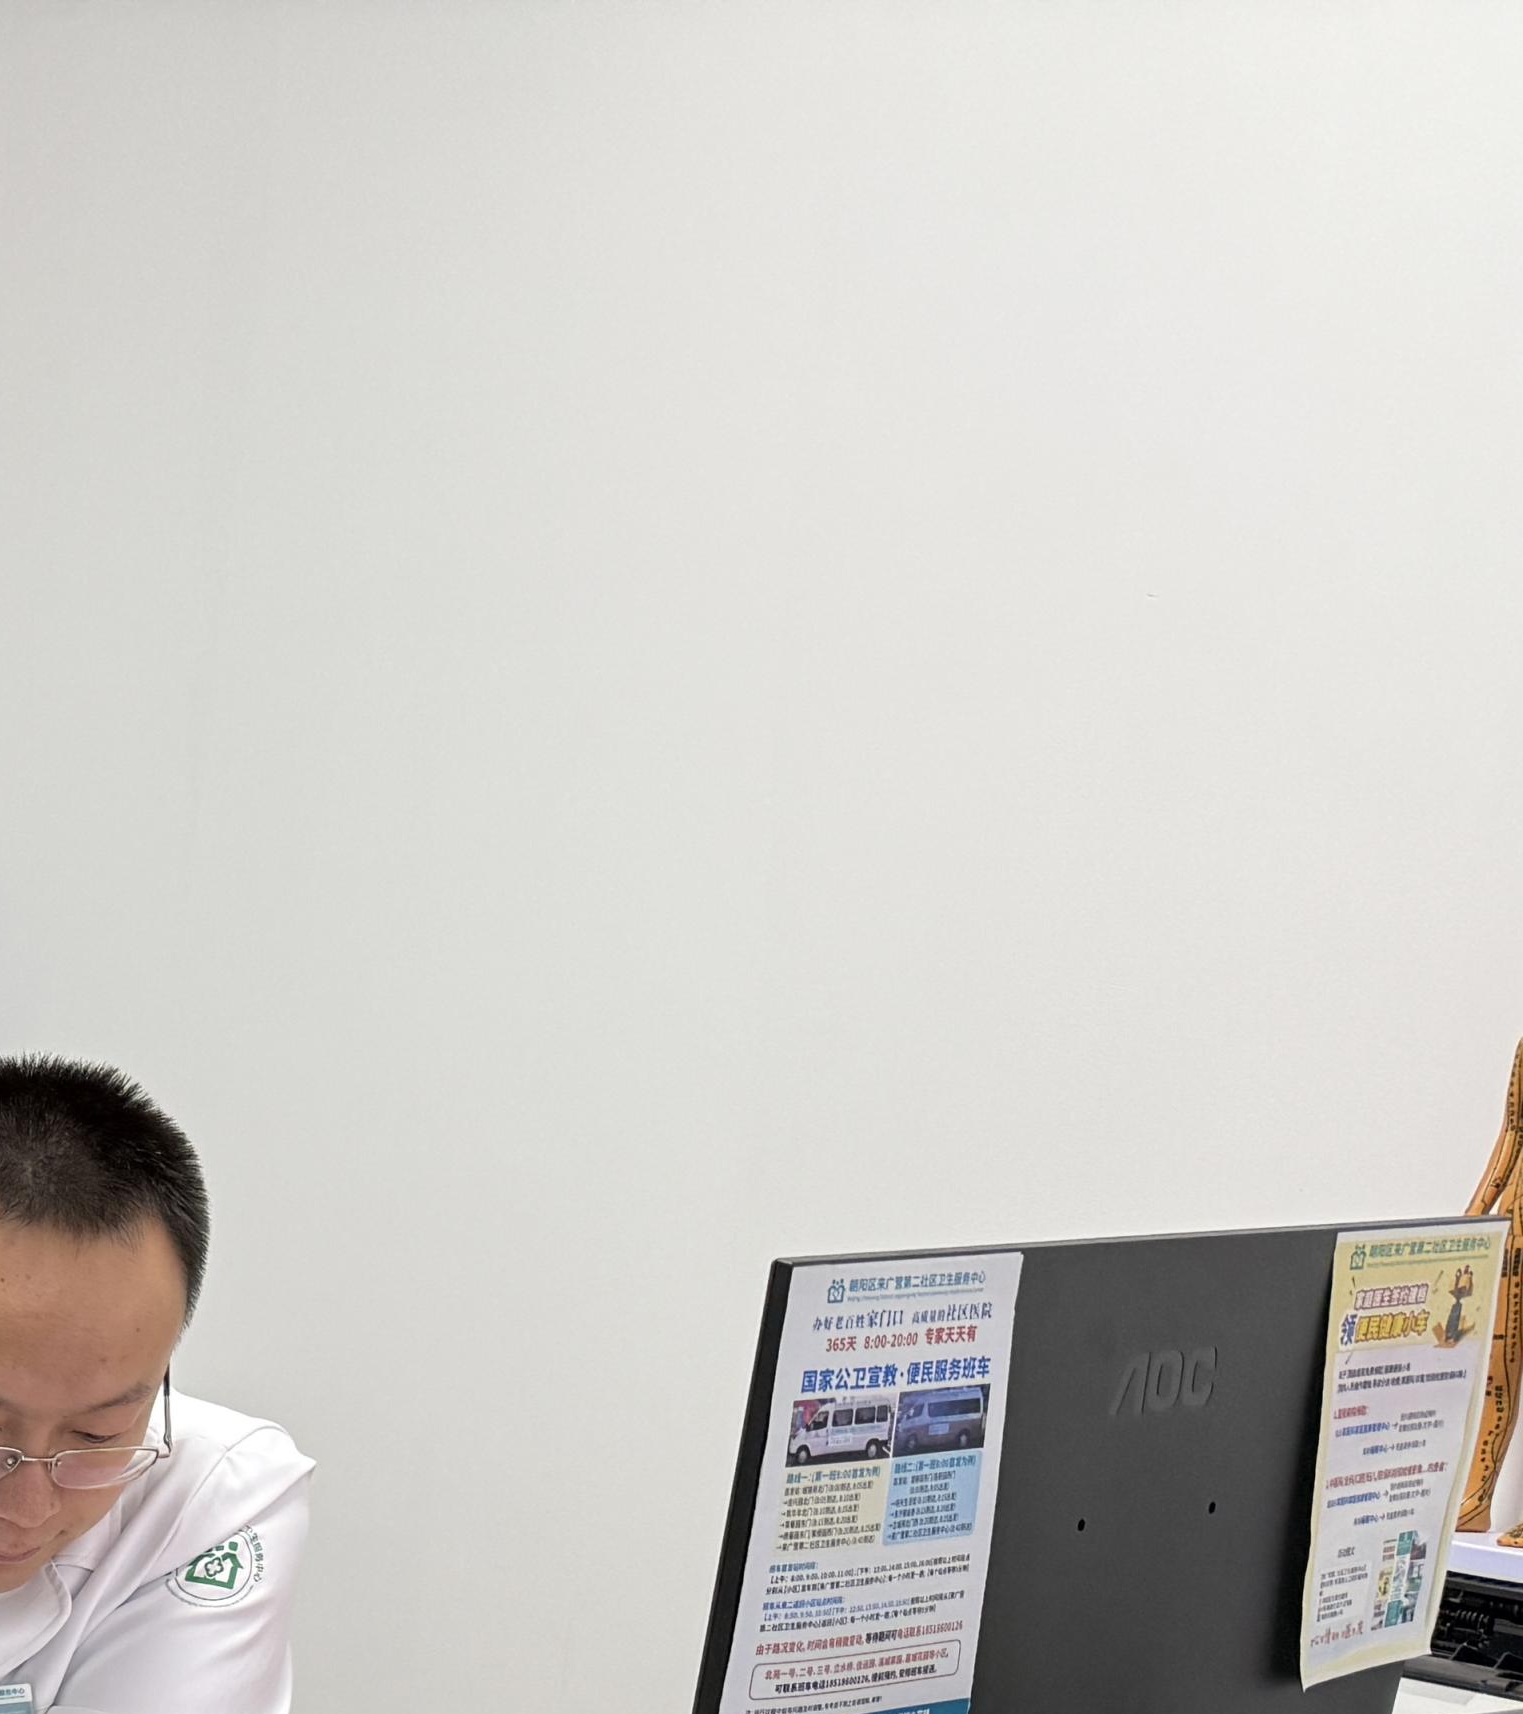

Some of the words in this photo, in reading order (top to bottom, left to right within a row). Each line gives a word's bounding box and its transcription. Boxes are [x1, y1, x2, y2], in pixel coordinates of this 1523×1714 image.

[812, 1309, 904, 1331] 办好老百姓家门口
[826, 1336, 857, 1352] 365天
[864, 1332, 918, 1349] 8:00-20:00
[924, 1324, 978, 1345] 专家天天有
[801, 1356, 991, 1394] 国家公卫宣教·便民服务班车
[1109, 1346, 1218, 1415] AOC
